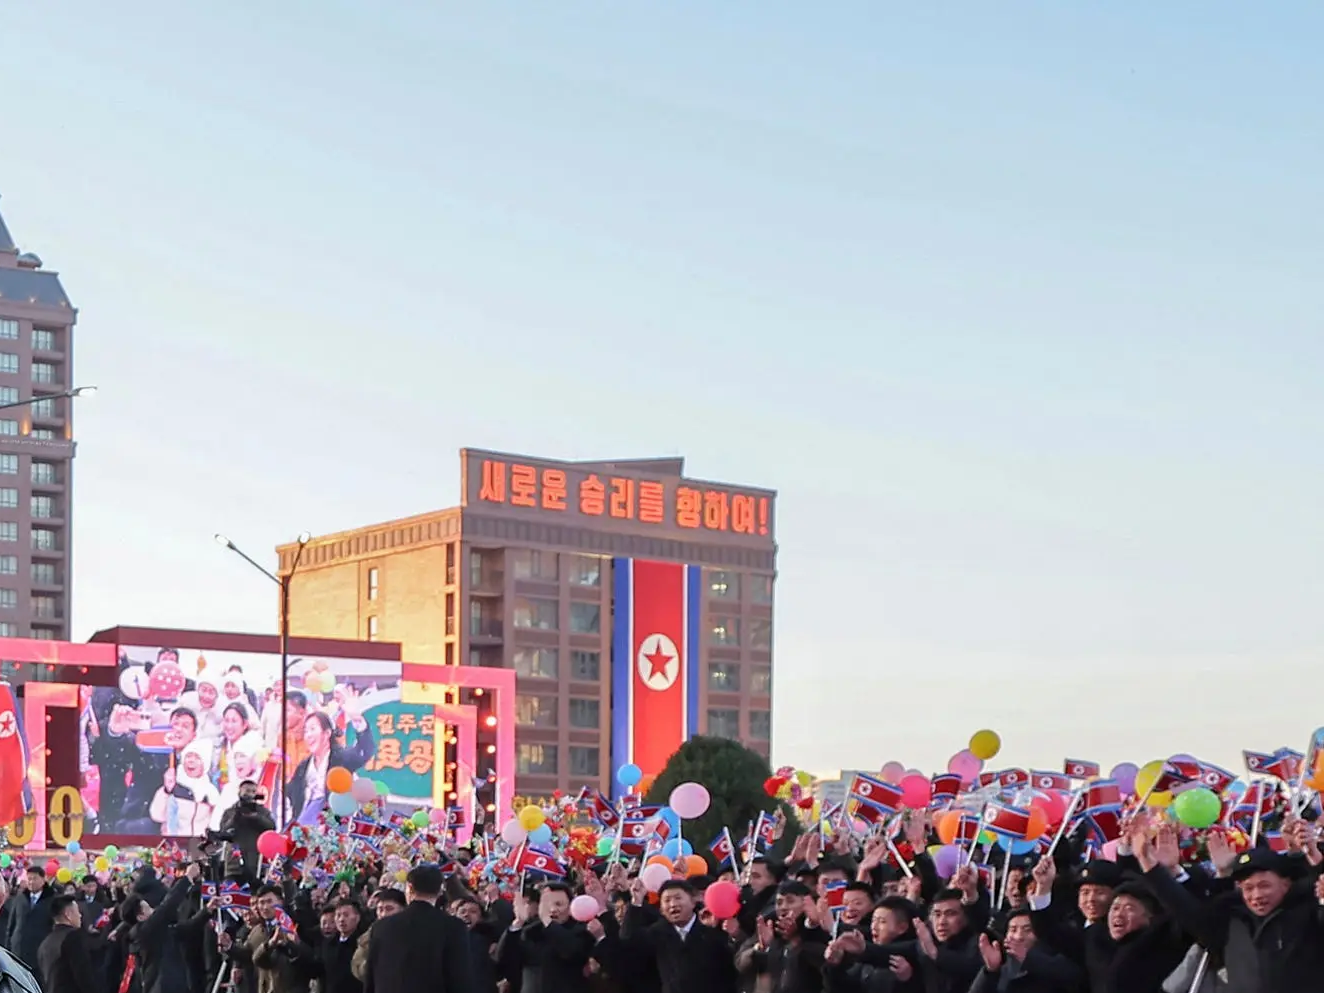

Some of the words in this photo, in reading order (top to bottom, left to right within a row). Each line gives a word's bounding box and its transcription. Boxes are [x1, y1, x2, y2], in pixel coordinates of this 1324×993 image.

[479, 460, 567, 510] 새로운
[579, 474, 664, 523] 승리를
[676, 487, 768, 536] 향하여!
